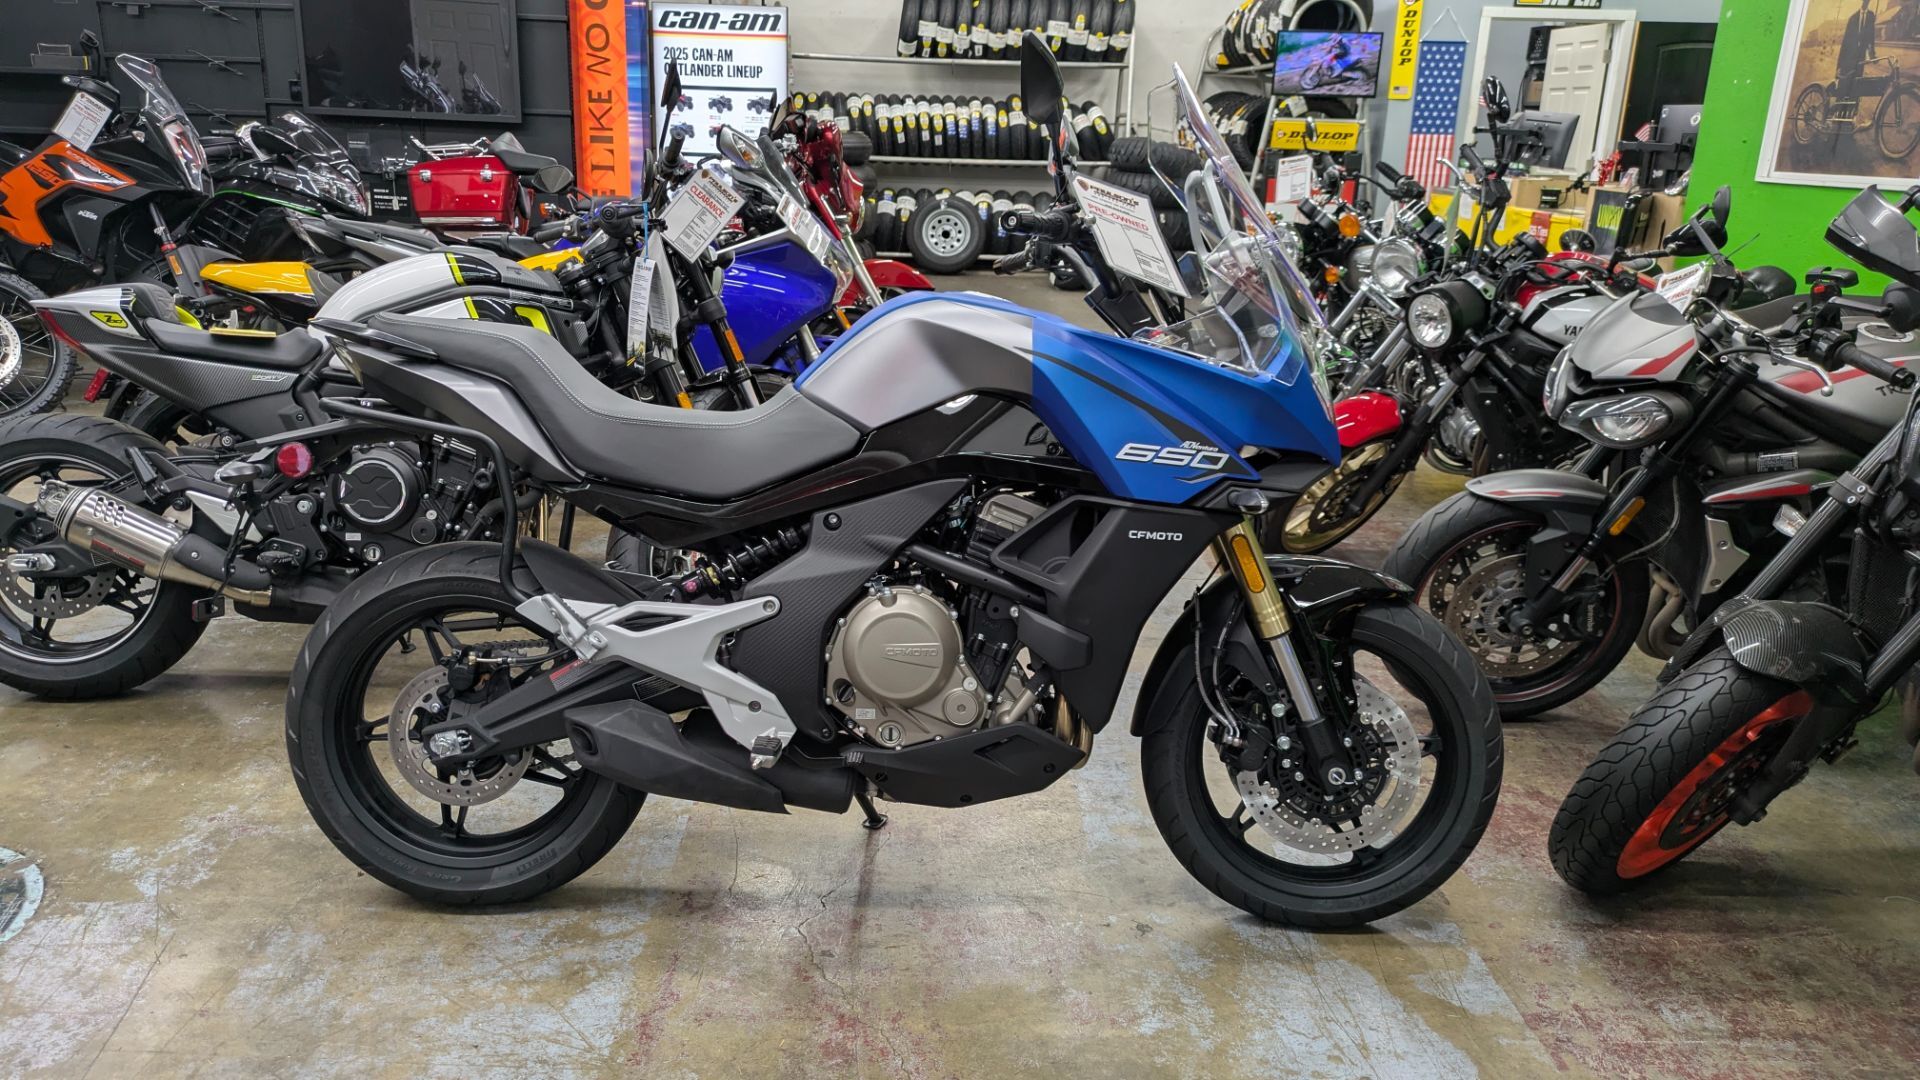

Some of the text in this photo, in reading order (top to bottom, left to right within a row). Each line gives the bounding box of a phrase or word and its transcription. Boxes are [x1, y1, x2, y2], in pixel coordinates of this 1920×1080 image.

[585, 23, 611, 76] NO
[1398, 9, 1418, 66] DUNLOP
[663, 46, 733, 62] 2025 CAN-AM
[664, 62, 763, 79] OTLANDER LINEUP
[588, 90, 615, 176] LIKE
[1287, 130, 1355, 140] DLOP
[690, 185, 726, 219] CLEARANCE
[1087, 203, 1149, 232] PRE-OWNED
[1115, 442, 1230, 470] 650
[1128, 530, 1183, 541] CFMOTO
[884, 647, 938, 656] CFMOTO
